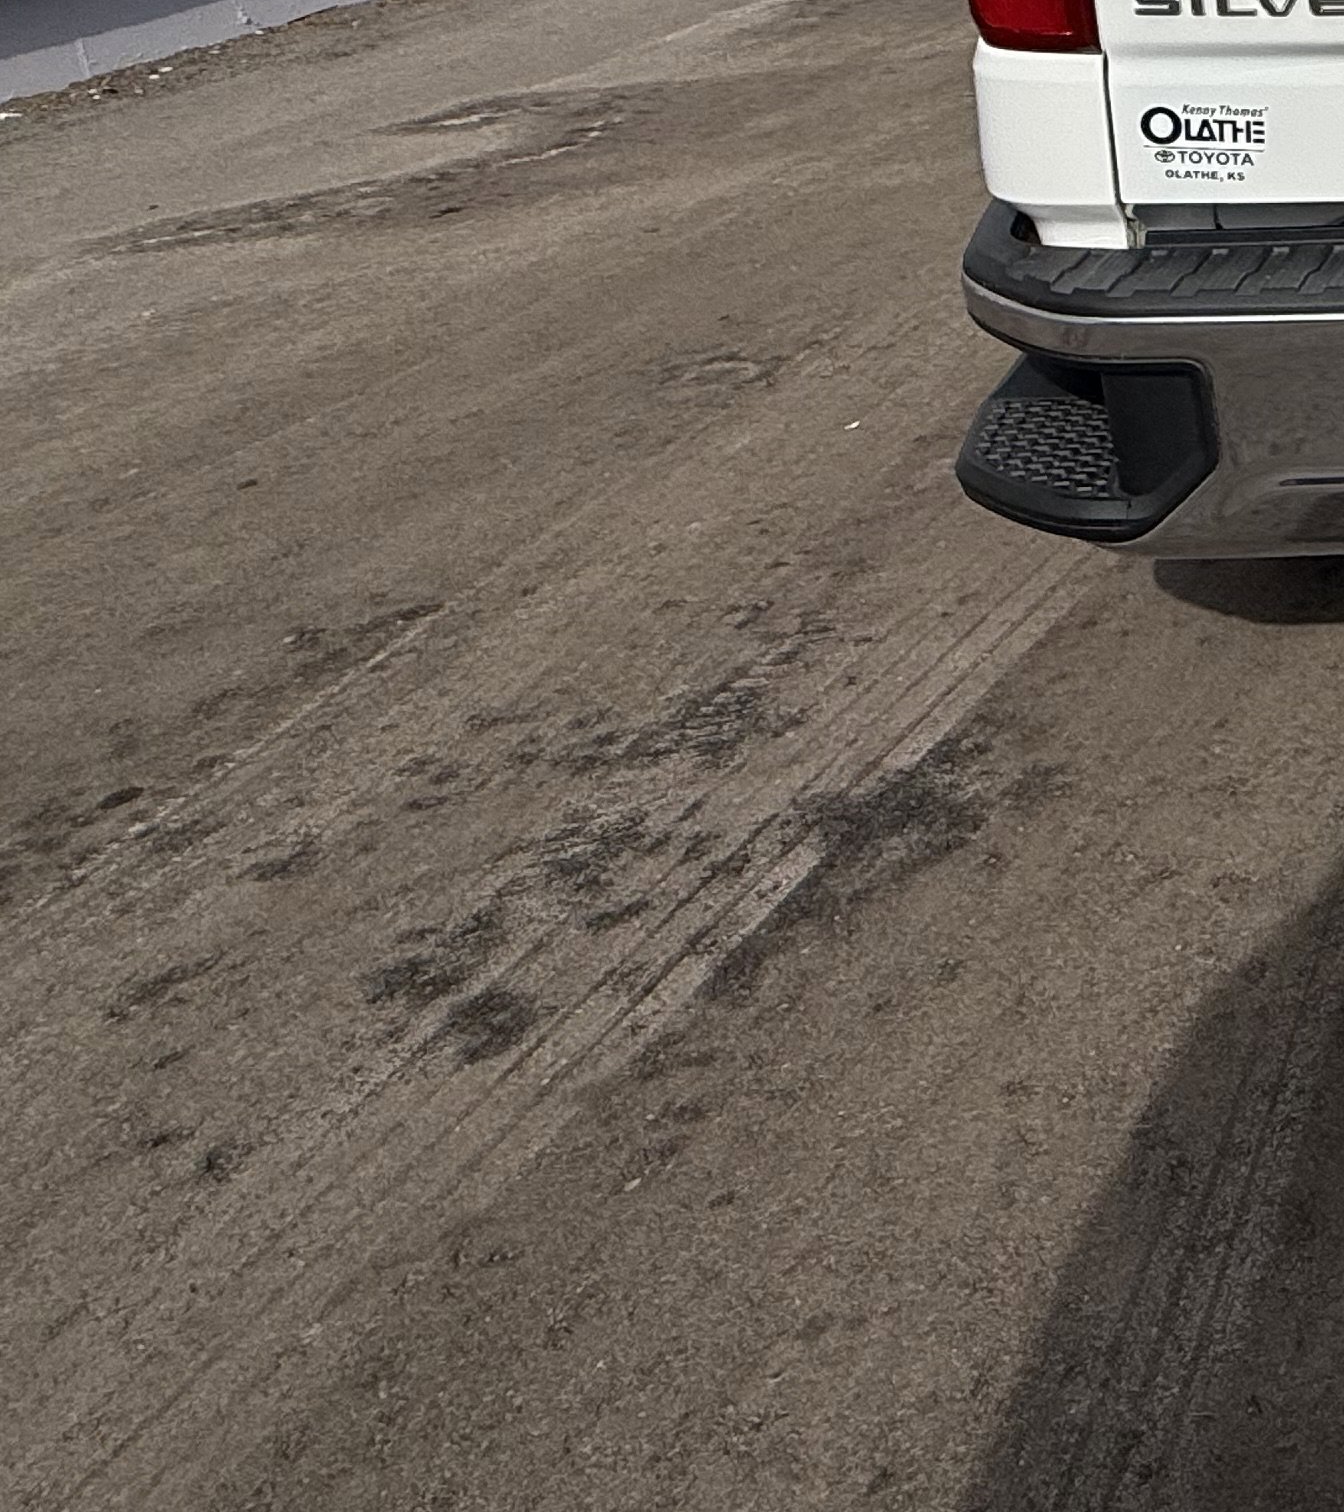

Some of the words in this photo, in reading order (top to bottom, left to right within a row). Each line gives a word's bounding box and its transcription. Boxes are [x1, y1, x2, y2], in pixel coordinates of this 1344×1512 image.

[1181, 104, 1217, 118] Kenny
[1140, 106, 1266, 145] OLATHE
[1177, 150, 1255, 166] TOYOTA
[1165, 169, 1224, 182] OLATHE,
[1227, 171, 1246, 181] KS
